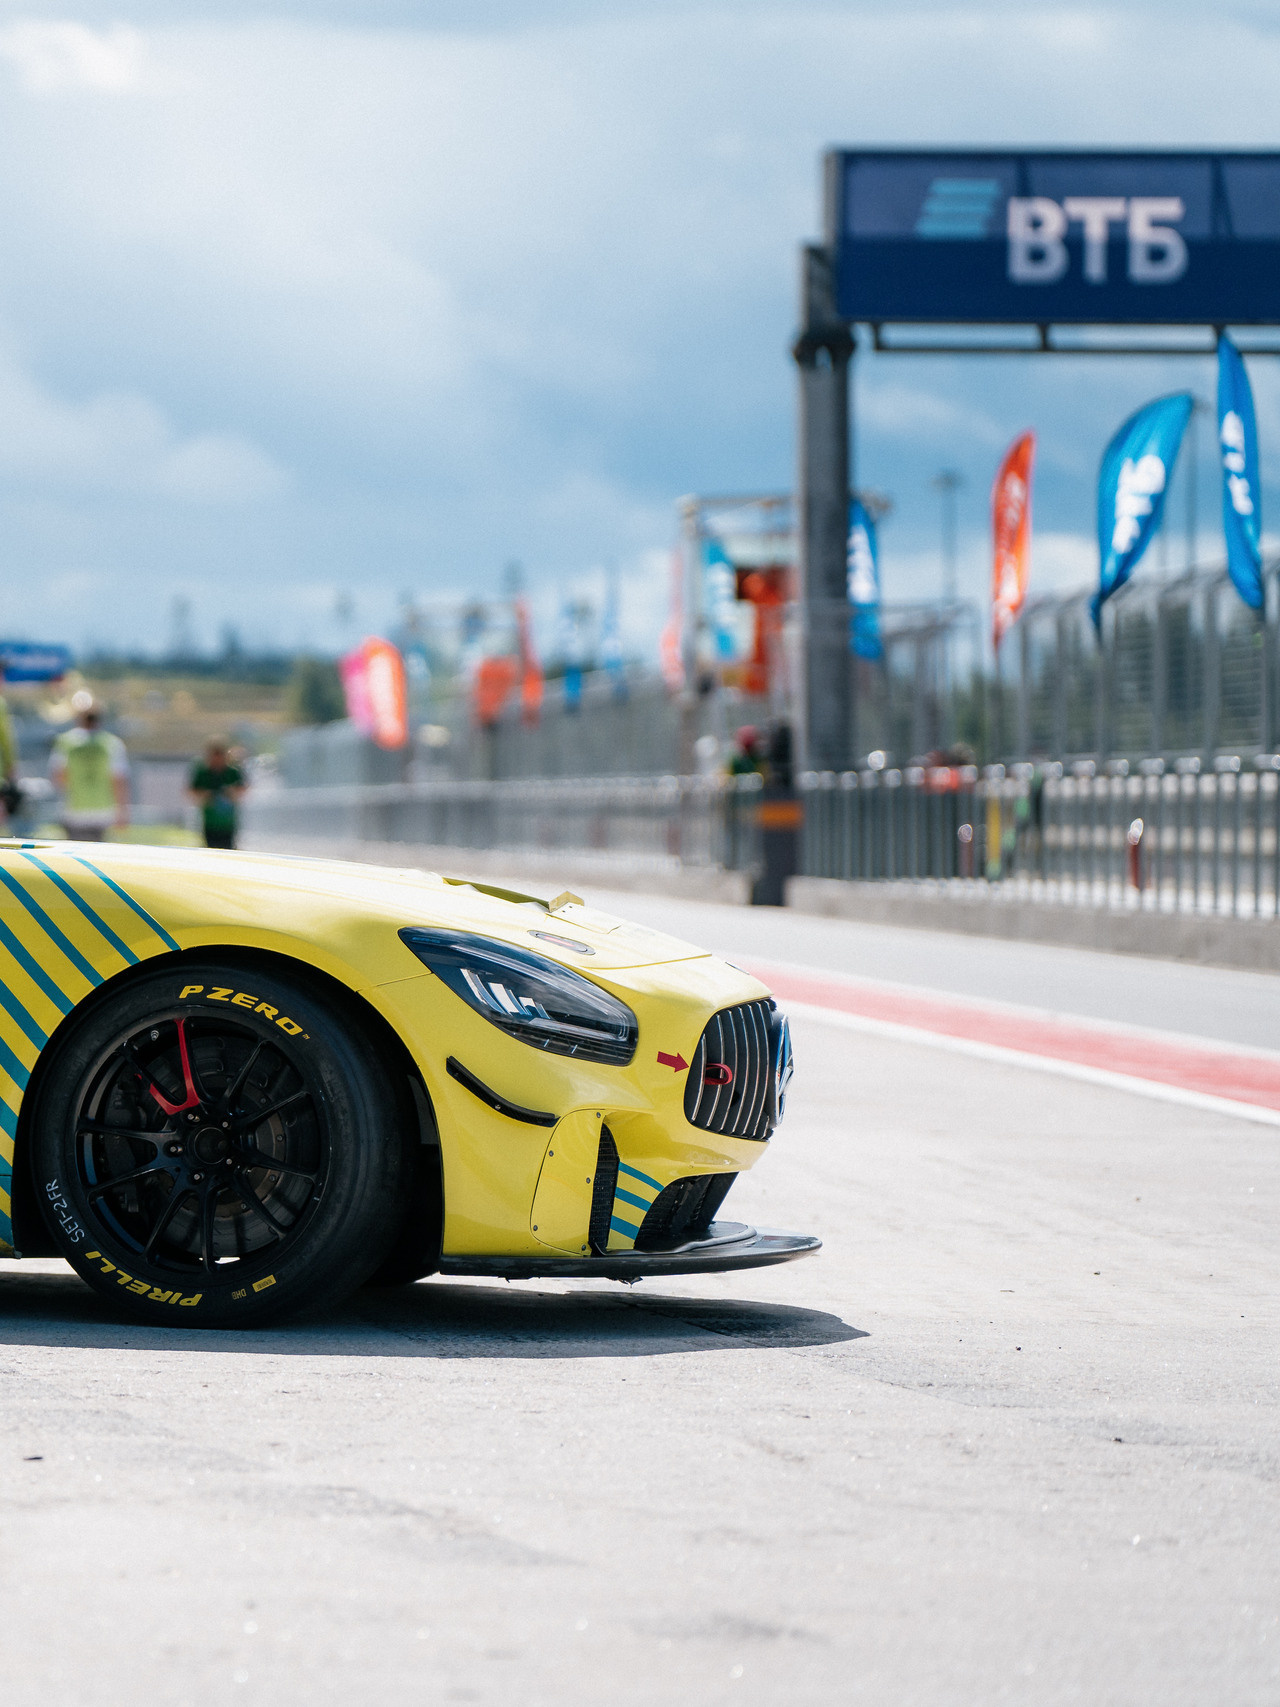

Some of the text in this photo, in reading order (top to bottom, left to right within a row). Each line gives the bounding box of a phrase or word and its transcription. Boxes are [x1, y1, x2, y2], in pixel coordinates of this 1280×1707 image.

[1008, 197, 1188, 285] ВТБ
[45, 1178, 85, 1243] SET-2FR
[85, 1250, 203, 1307] PIRELLI
